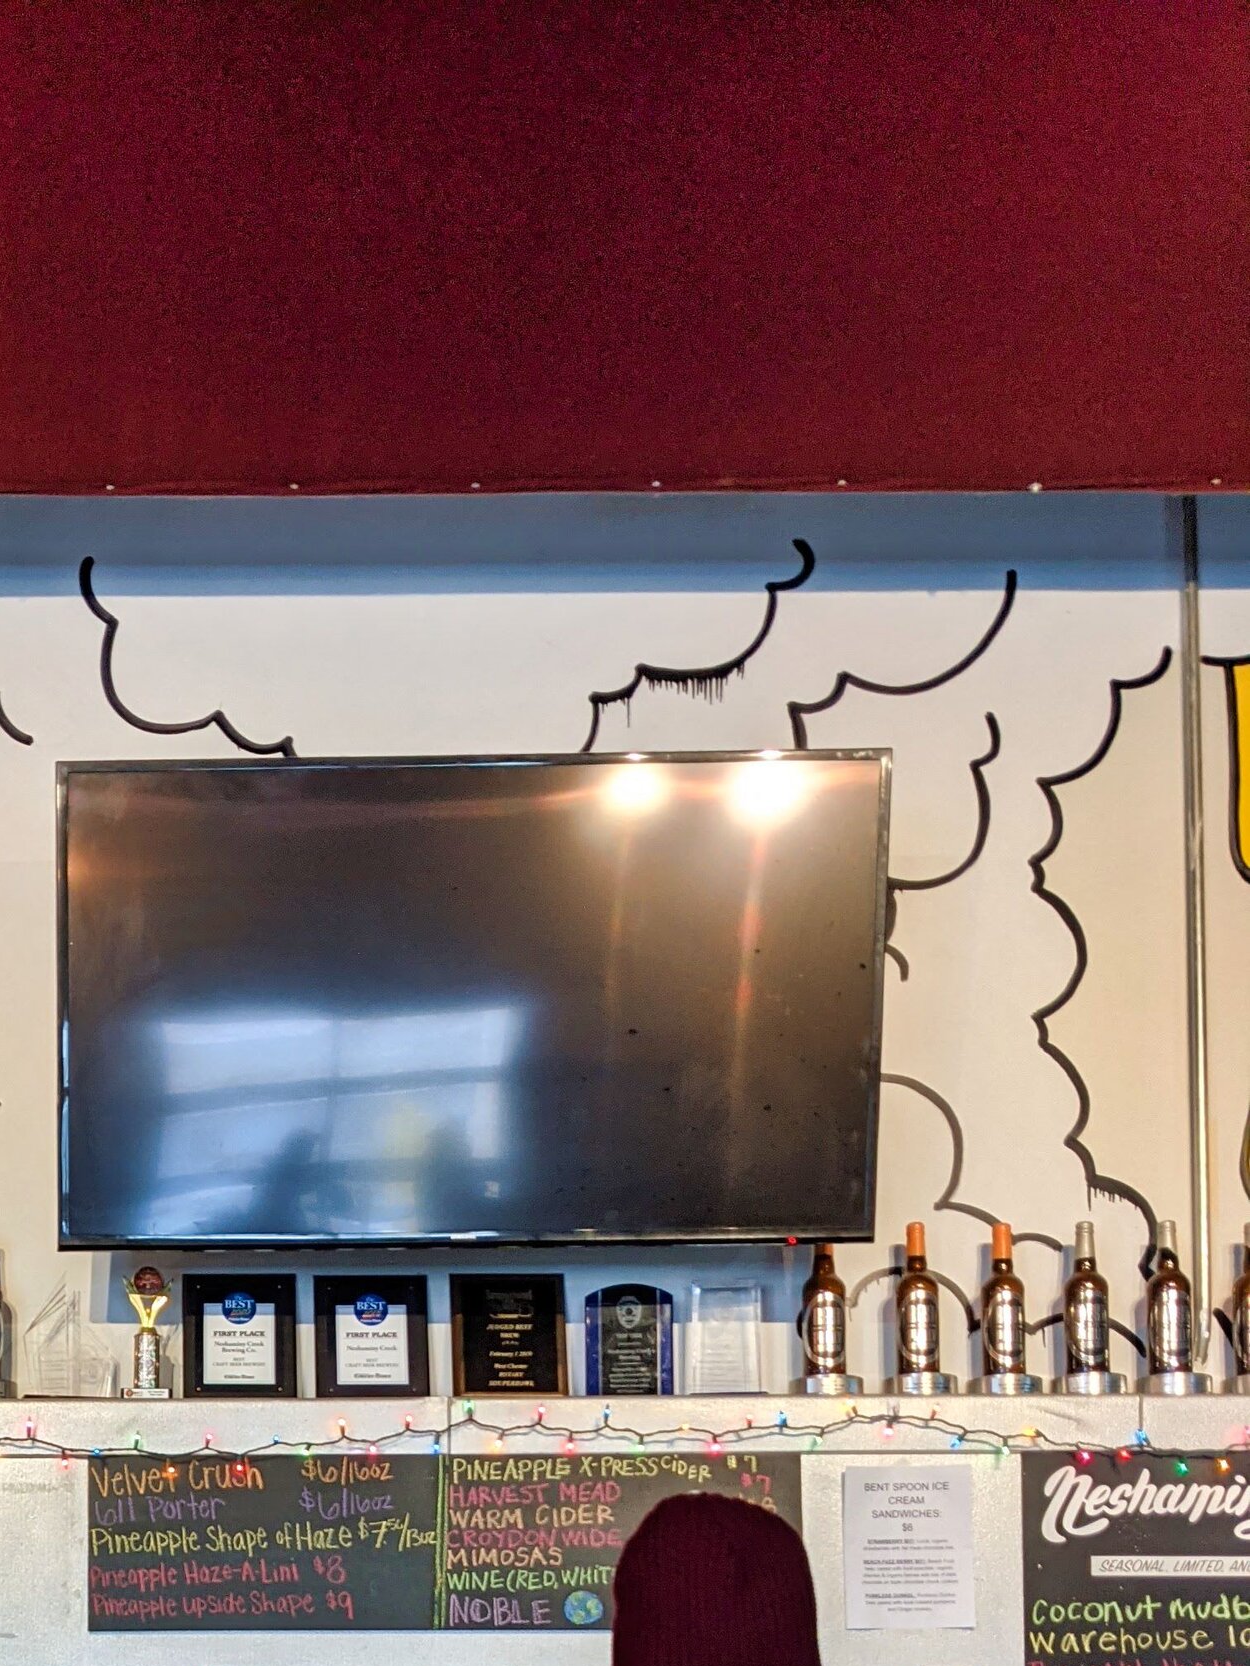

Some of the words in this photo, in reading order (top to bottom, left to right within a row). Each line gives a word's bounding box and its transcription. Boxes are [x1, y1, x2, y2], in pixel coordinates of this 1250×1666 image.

[224, 1300, 252, 1309] BEST
[91, 1464, 178, 1497] Velvet
[188, 1457, 265, 1490] Crush
[864, 1482, 889, 1492] BENT
[892, 1482, 929, 1491] SPOON
[932, 1482, 950, 1490] ICE
[450, 1483, 550, 1504] HARVEST
[559, 1481, 621, 1502] MEAD
[888, 1496, 925, 1505] CREAM
[149, 1492, 226, 1522] Porter
[450, 1508, 525, 1530] WARM
[535, 1505, 615, 1529] CIDER
[90, 1525, 200, 1556] Pineapple
[295, 1523, 352, 1551] Haze
[447, 1529, 555, 1548] CROYDON
[447, 1547, 563, 1569] MIMOSAS
[90, 1561, 178, 1592] Pineapple
[314, 1555, 346, 1585] $8
[93, 1594, 177, 1622] Pineapple
[325, 1591, 354, 1620] $9
[450, 1594, 552, 1628] NOBLE
[1029, 1627, 1214, 1655] warehouse
